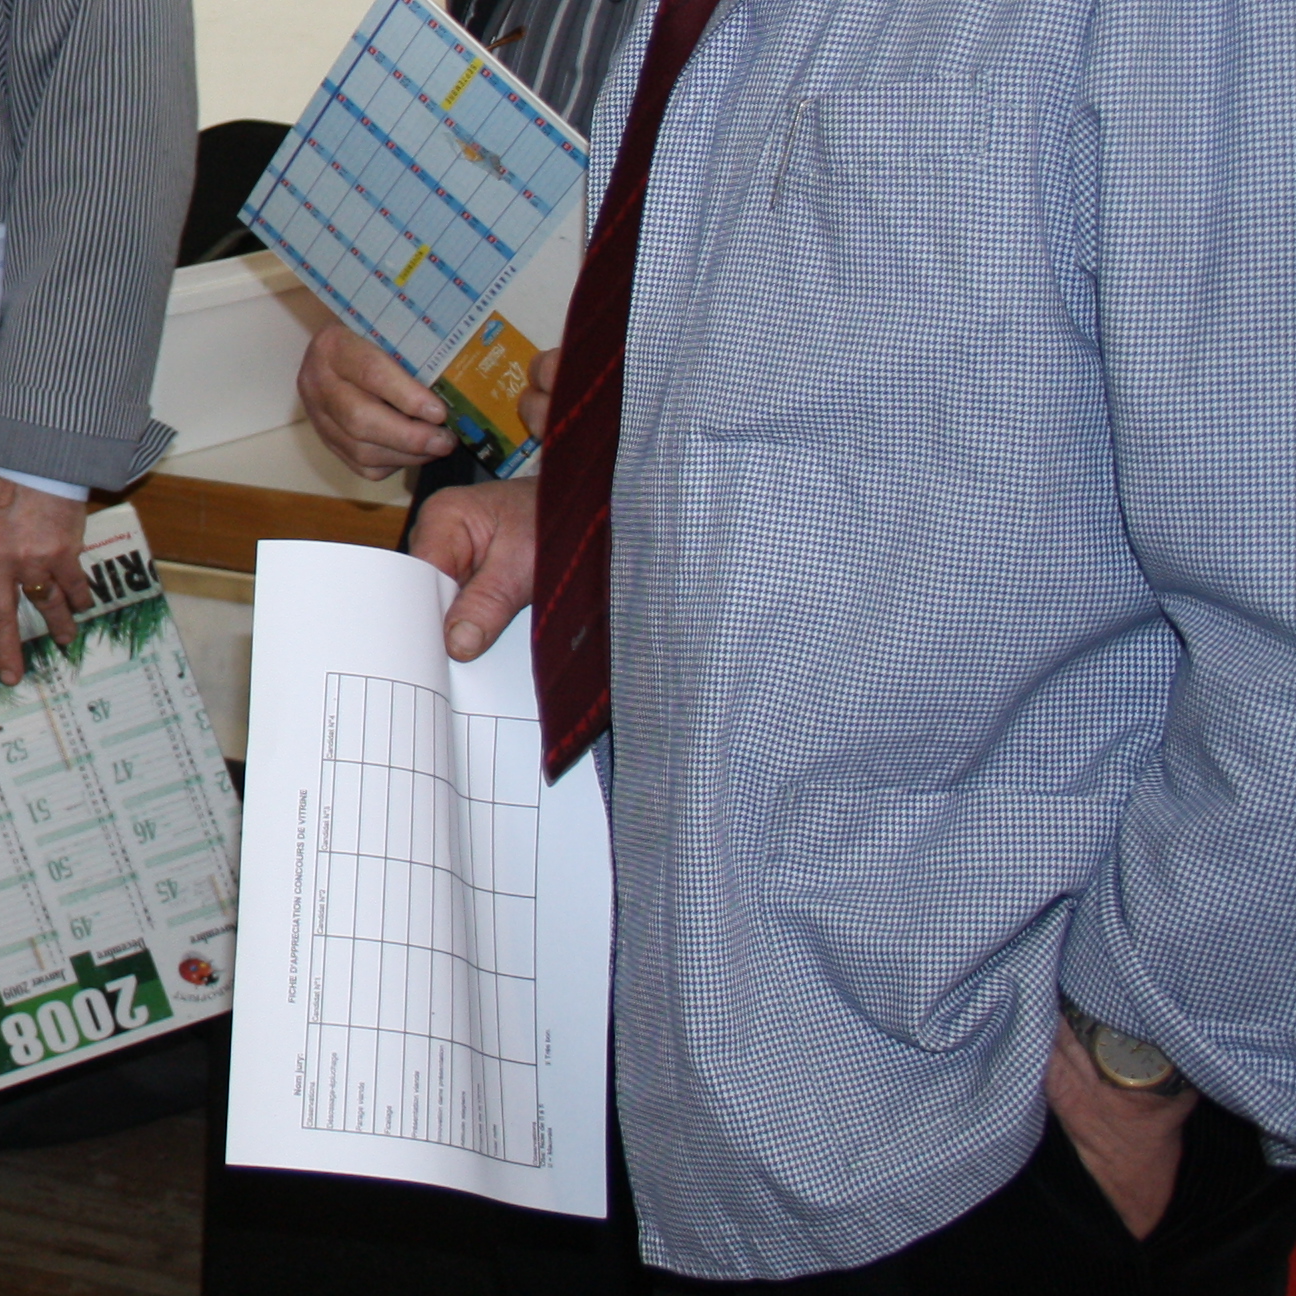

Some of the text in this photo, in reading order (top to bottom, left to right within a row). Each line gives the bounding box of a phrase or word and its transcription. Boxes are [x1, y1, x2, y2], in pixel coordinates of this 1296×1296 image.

[443, 63, 478, 105] SEPTEMBRE
[474, 265, 516, 313] PLANNING
[461, 313, 475, 328] DE
[0, 736, 30, 766] 52
[108, 756, 137, 785] 47
[24, 796, 53, 825] 51
[130, 816, 160, 845] 46
[45, 854, 74, 883] 50
[153, 875, 182, 904] 45
[288, 789, 307, 1003] FICHE D'APPRECIATION CONCOURS DE VITRINE
[66, 912, 96, 941] 49
[95, 936, 146, 964] Décembre
[0, 967, 68, 1002] Janvier 2009
[0, 975, 150, 1066] 2008
[293, 1053, 304, 1095] Nom jury:
[306, 1081, 315, 1126] Observations
